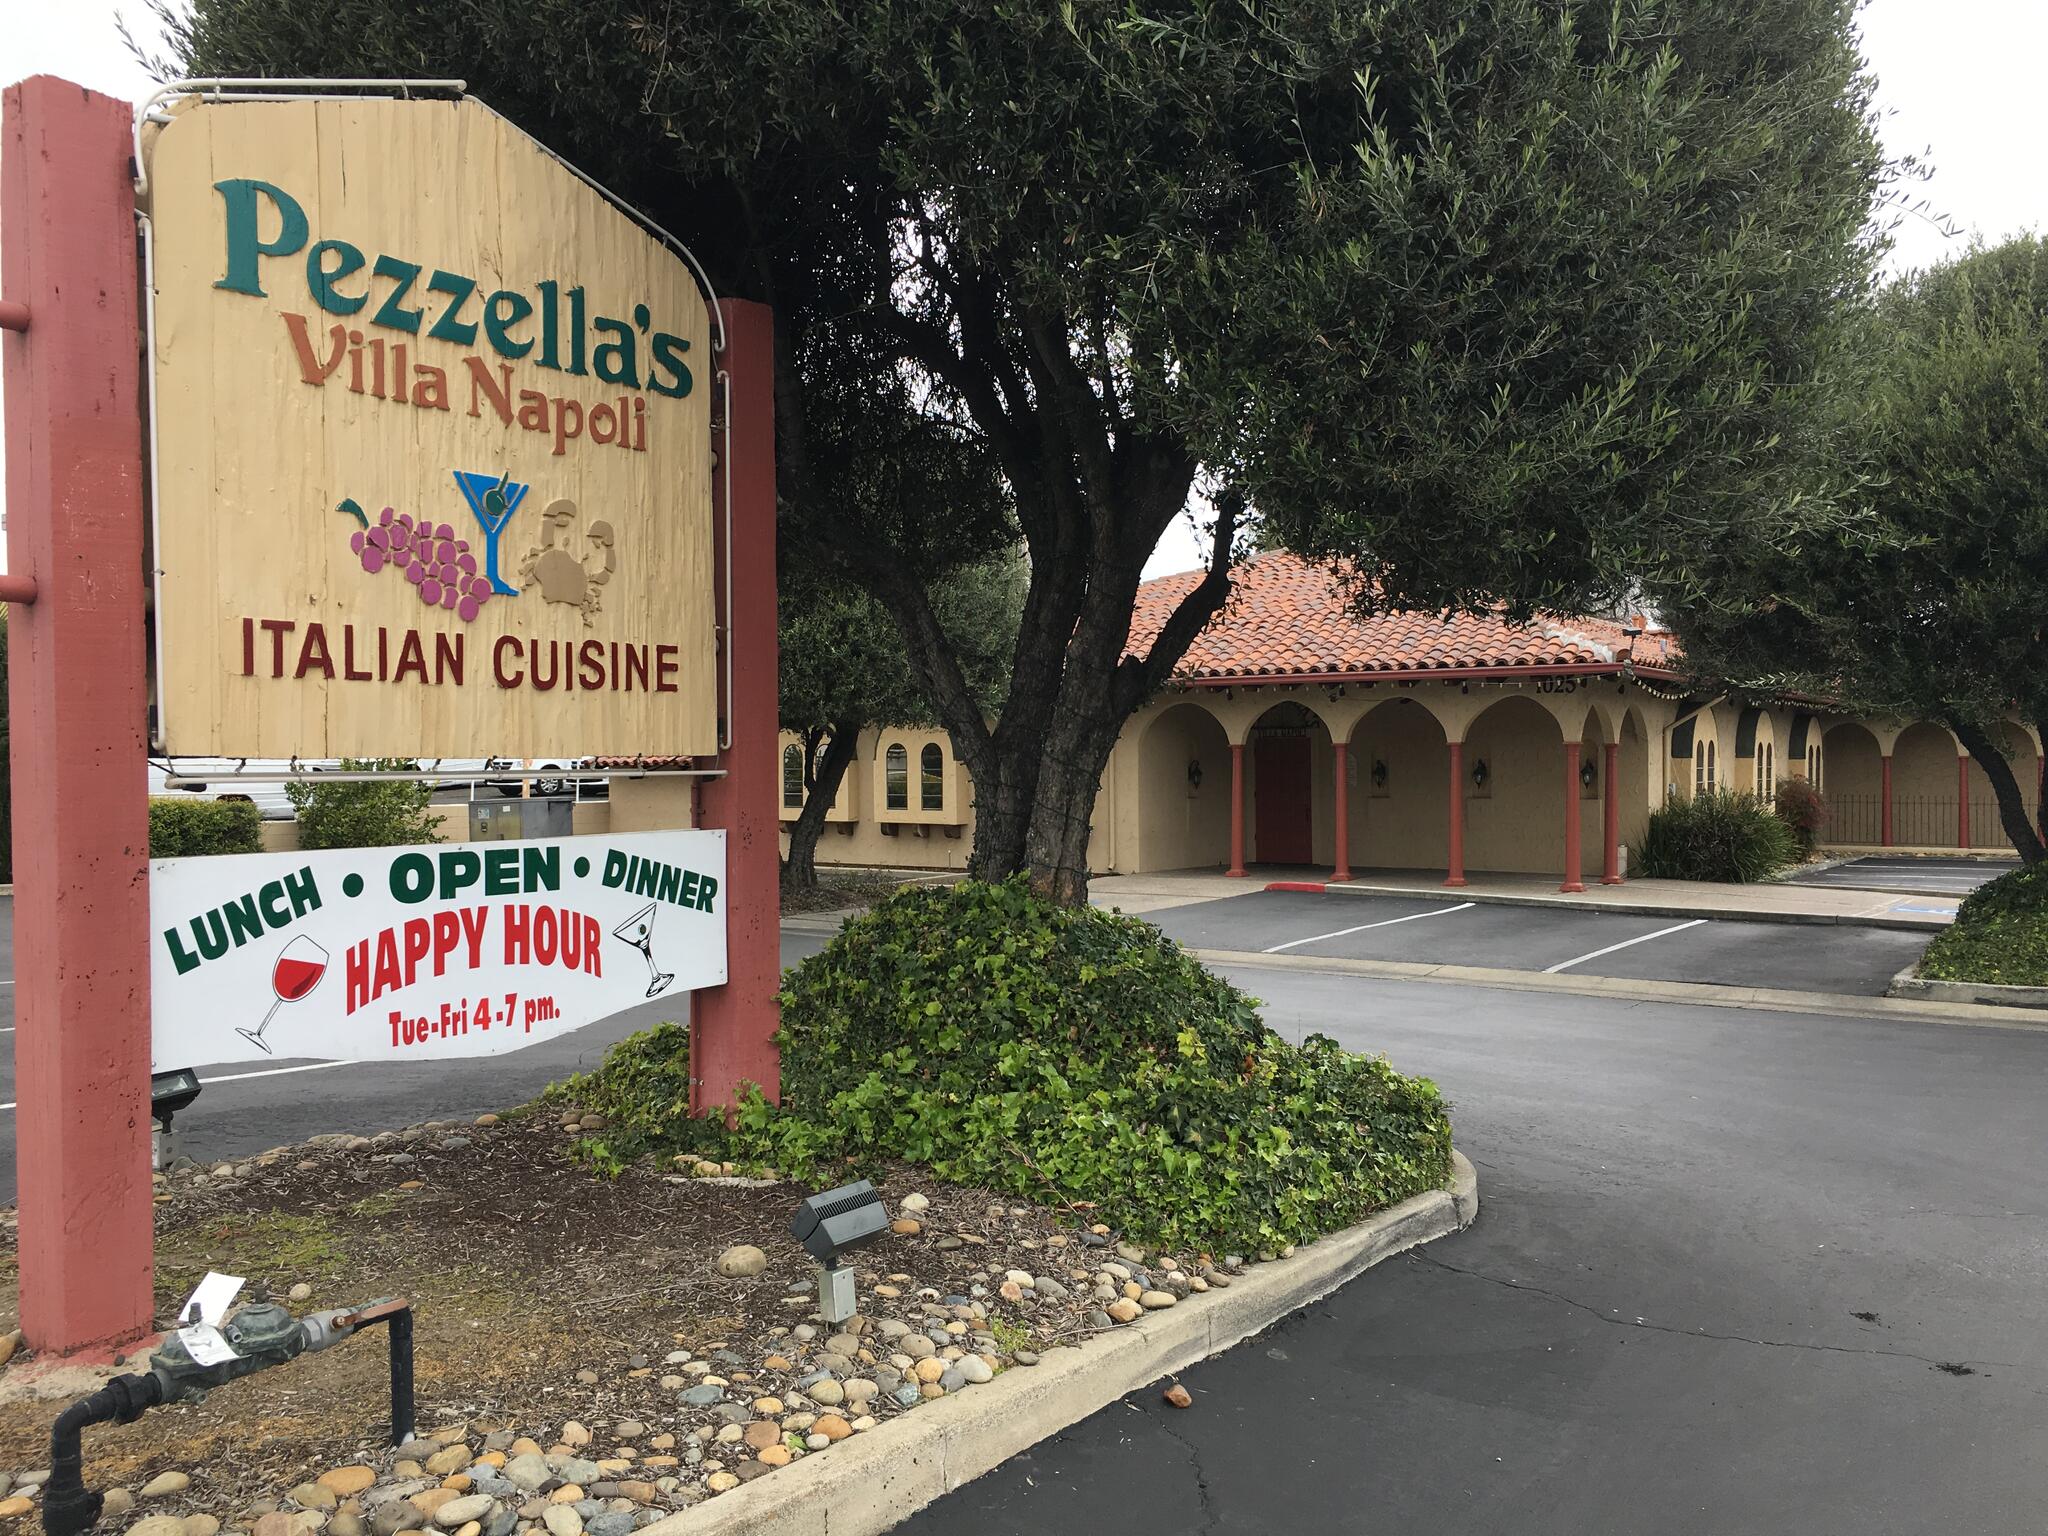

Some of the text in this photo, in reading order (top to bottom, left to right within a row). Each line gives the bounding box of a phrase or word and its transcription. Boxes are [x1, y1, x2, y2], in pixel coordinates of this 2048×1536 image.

[211, 178, 694, 399] Pezzella's
[279, 311, 647, 455] Villa Napoli
[242, 617, 679, 693] ITALIAN CUISINE
[163, 846, 719, 976] LUNCH OPEN DINNER
[346, 904, 602, 1016] HAPPY HOUR
[388, 998, 468, 1047] Tue-Fri
[524, 996, 561, 1033] pm.
